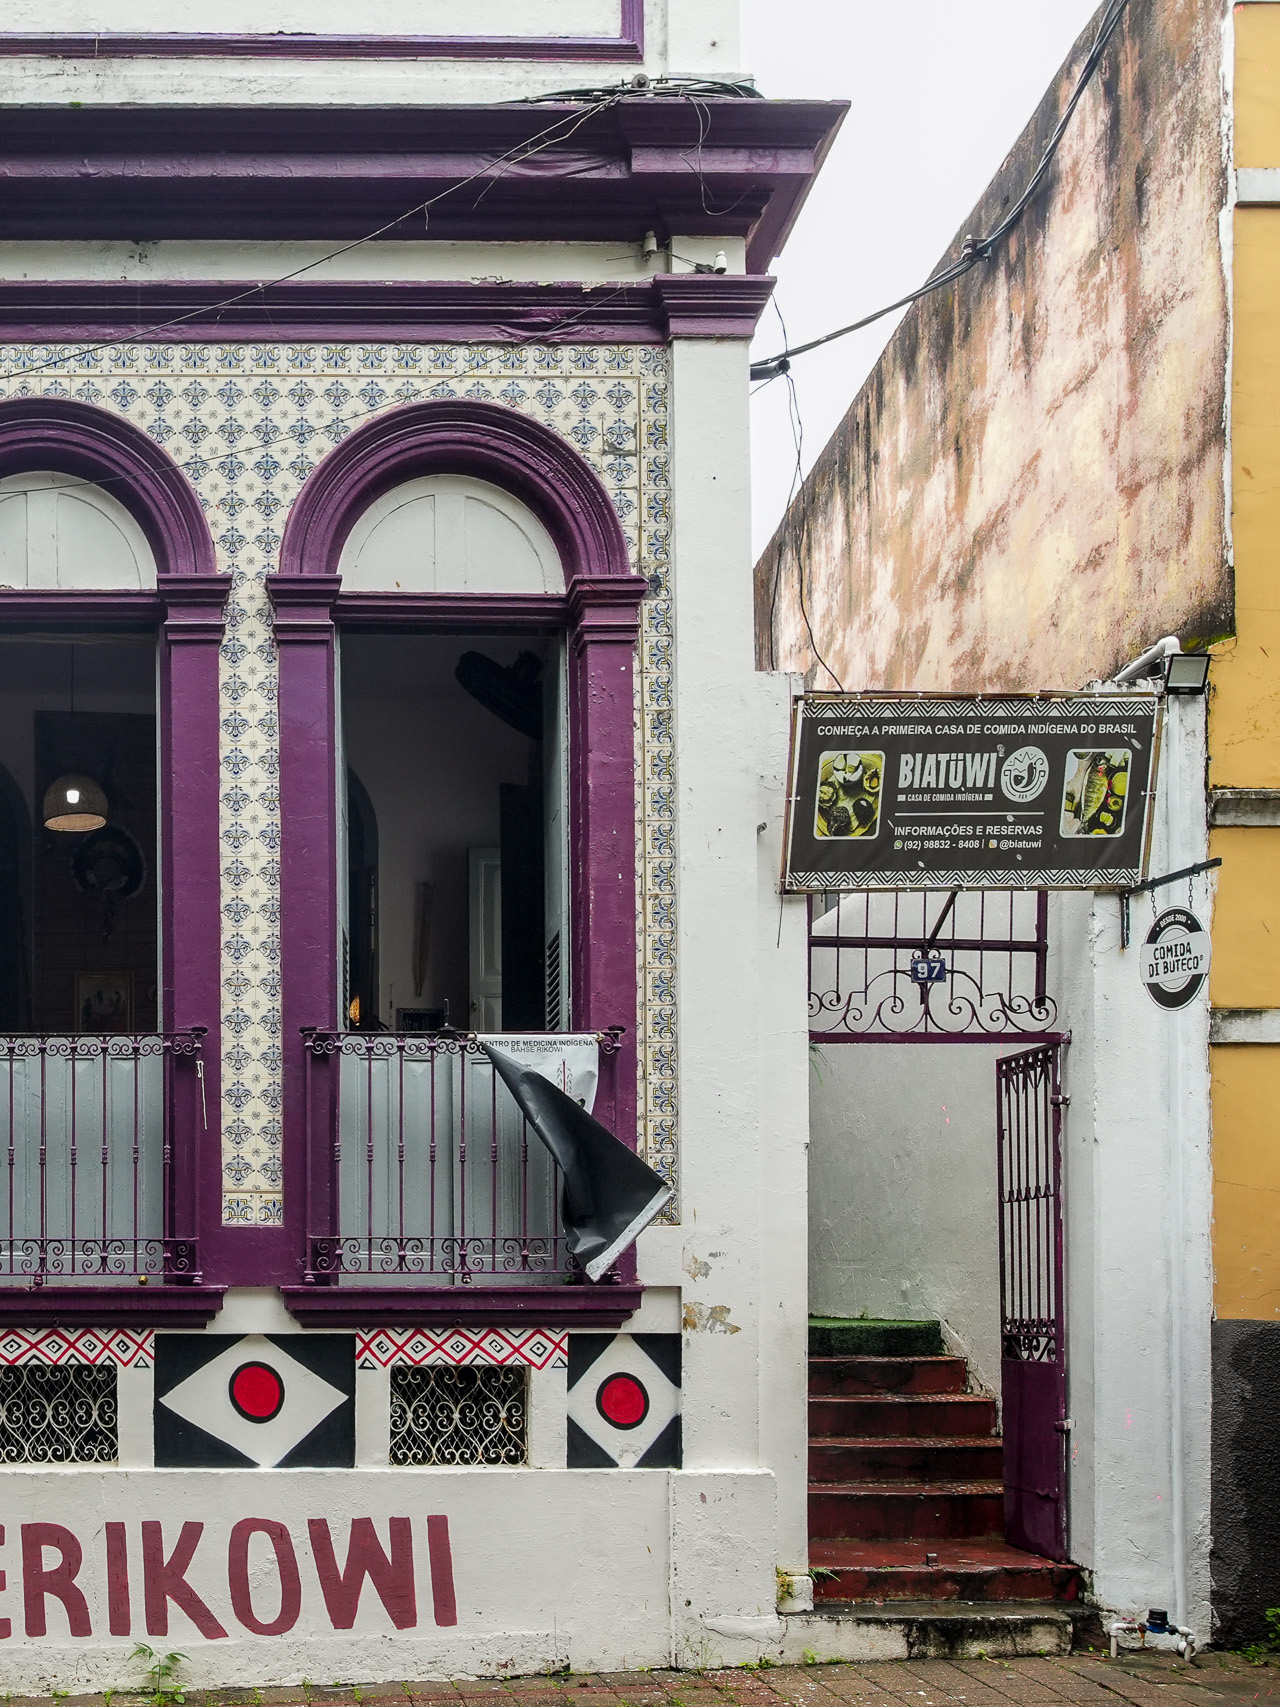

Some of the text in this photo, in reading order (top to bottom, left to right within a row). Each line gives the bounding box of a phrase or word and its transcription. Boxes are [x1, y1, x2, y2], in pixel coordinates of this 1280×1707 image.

[817, 722, 1137, 738] CONHEÇA A PRIMEIRA CASA DE COMIDA INDÍGENA DO BRASIL
[907, 794, 922, 802] CASA
[955, 792, 983, 801] INDÍGENA
[894, 824, 1043, 837] INFORMAÇÕES E RESERVAS
[904, 840, 921, 850] (92)
[923, 840, 950, 848] 98832
[958, 840, 980, 848] 8408
[999, 839, 1042, 850] @biatuwi
[1160, 914, 1187, 927] DESDE 2000
[1153, 942, 1192, 961] COMIDA
[917, 962, 941, 978] 97
[1148, 963, 1160, 978] DI
